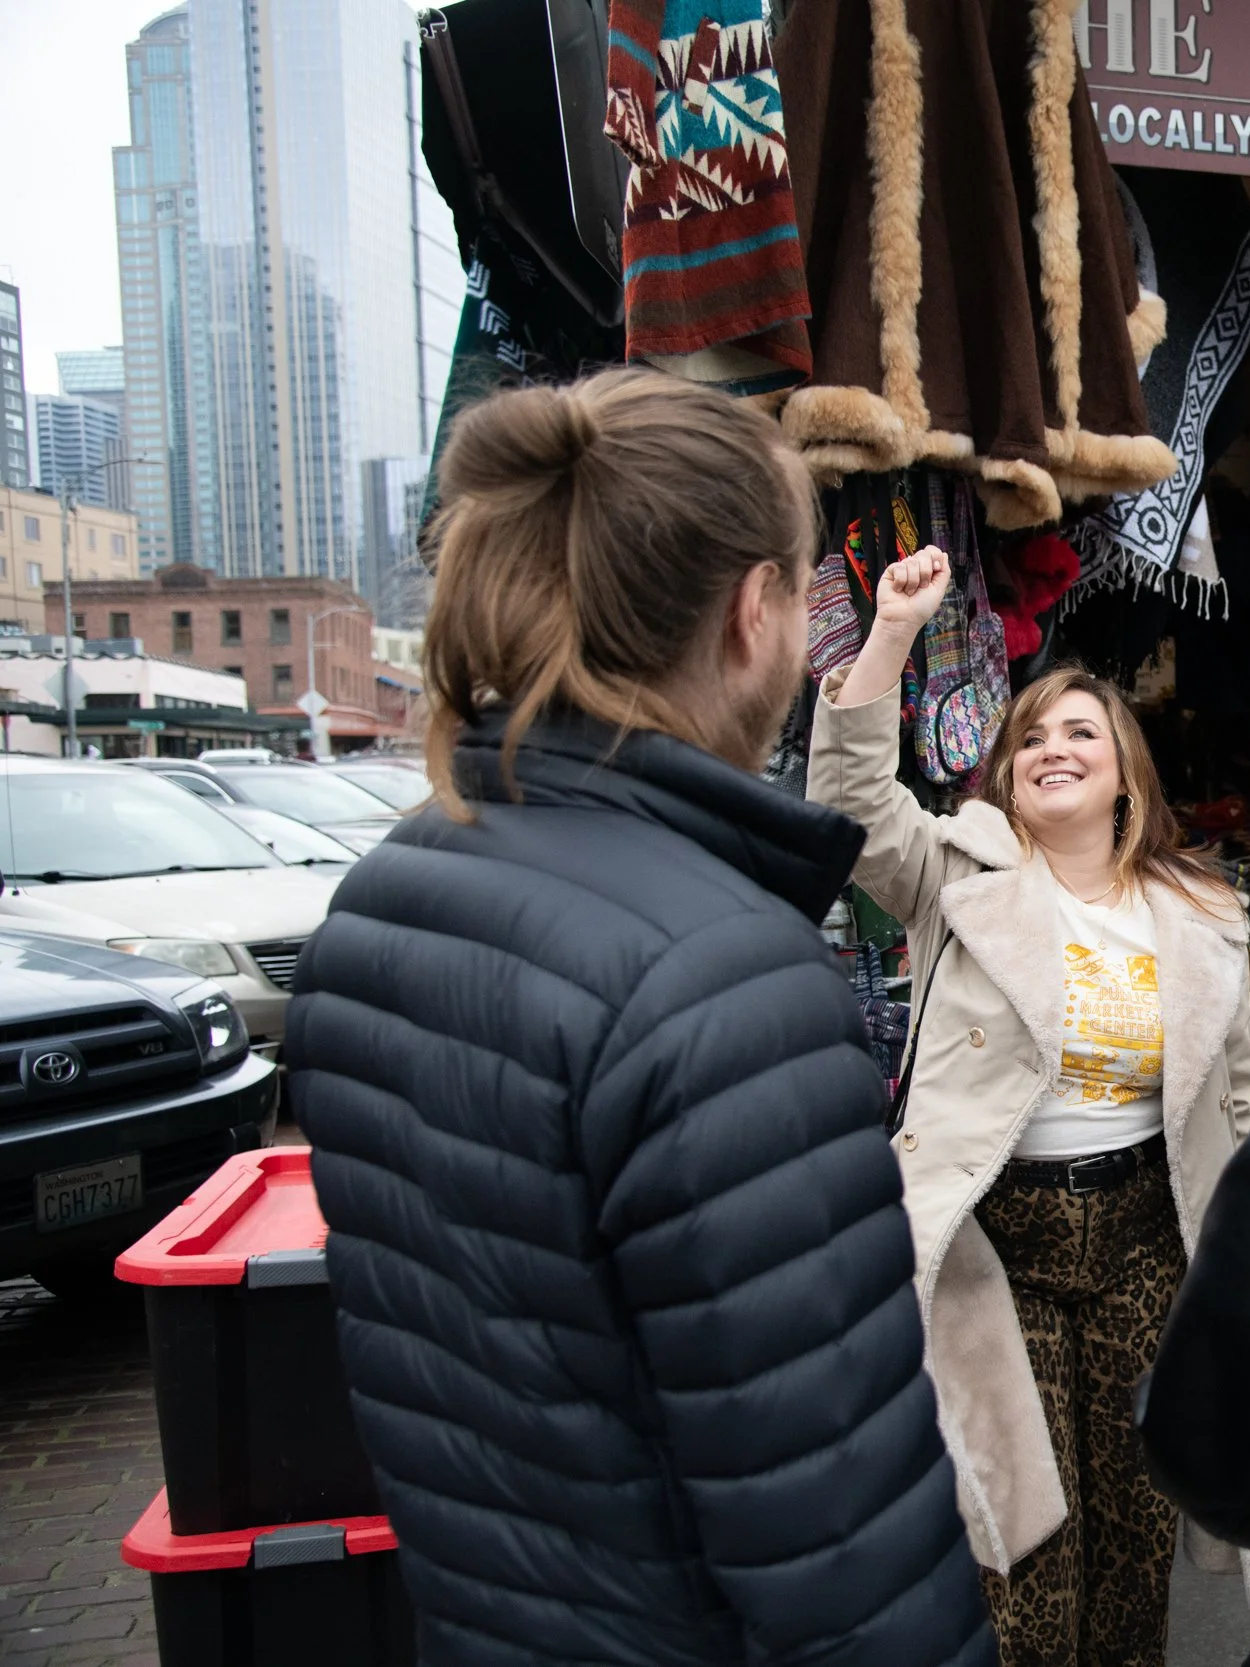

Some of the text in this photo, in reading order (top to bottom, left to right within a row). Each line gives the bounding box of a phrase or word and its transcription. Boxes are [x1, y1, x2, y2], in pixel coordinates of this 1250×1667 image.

[1080, 1000, 1145, 1020] MARKET
[1089, 1018, 1156, 1039] CENTER
[45, 1171, 103, 1189] WASHINGTON
[44, 1174, 138, 1222] CGH7377
